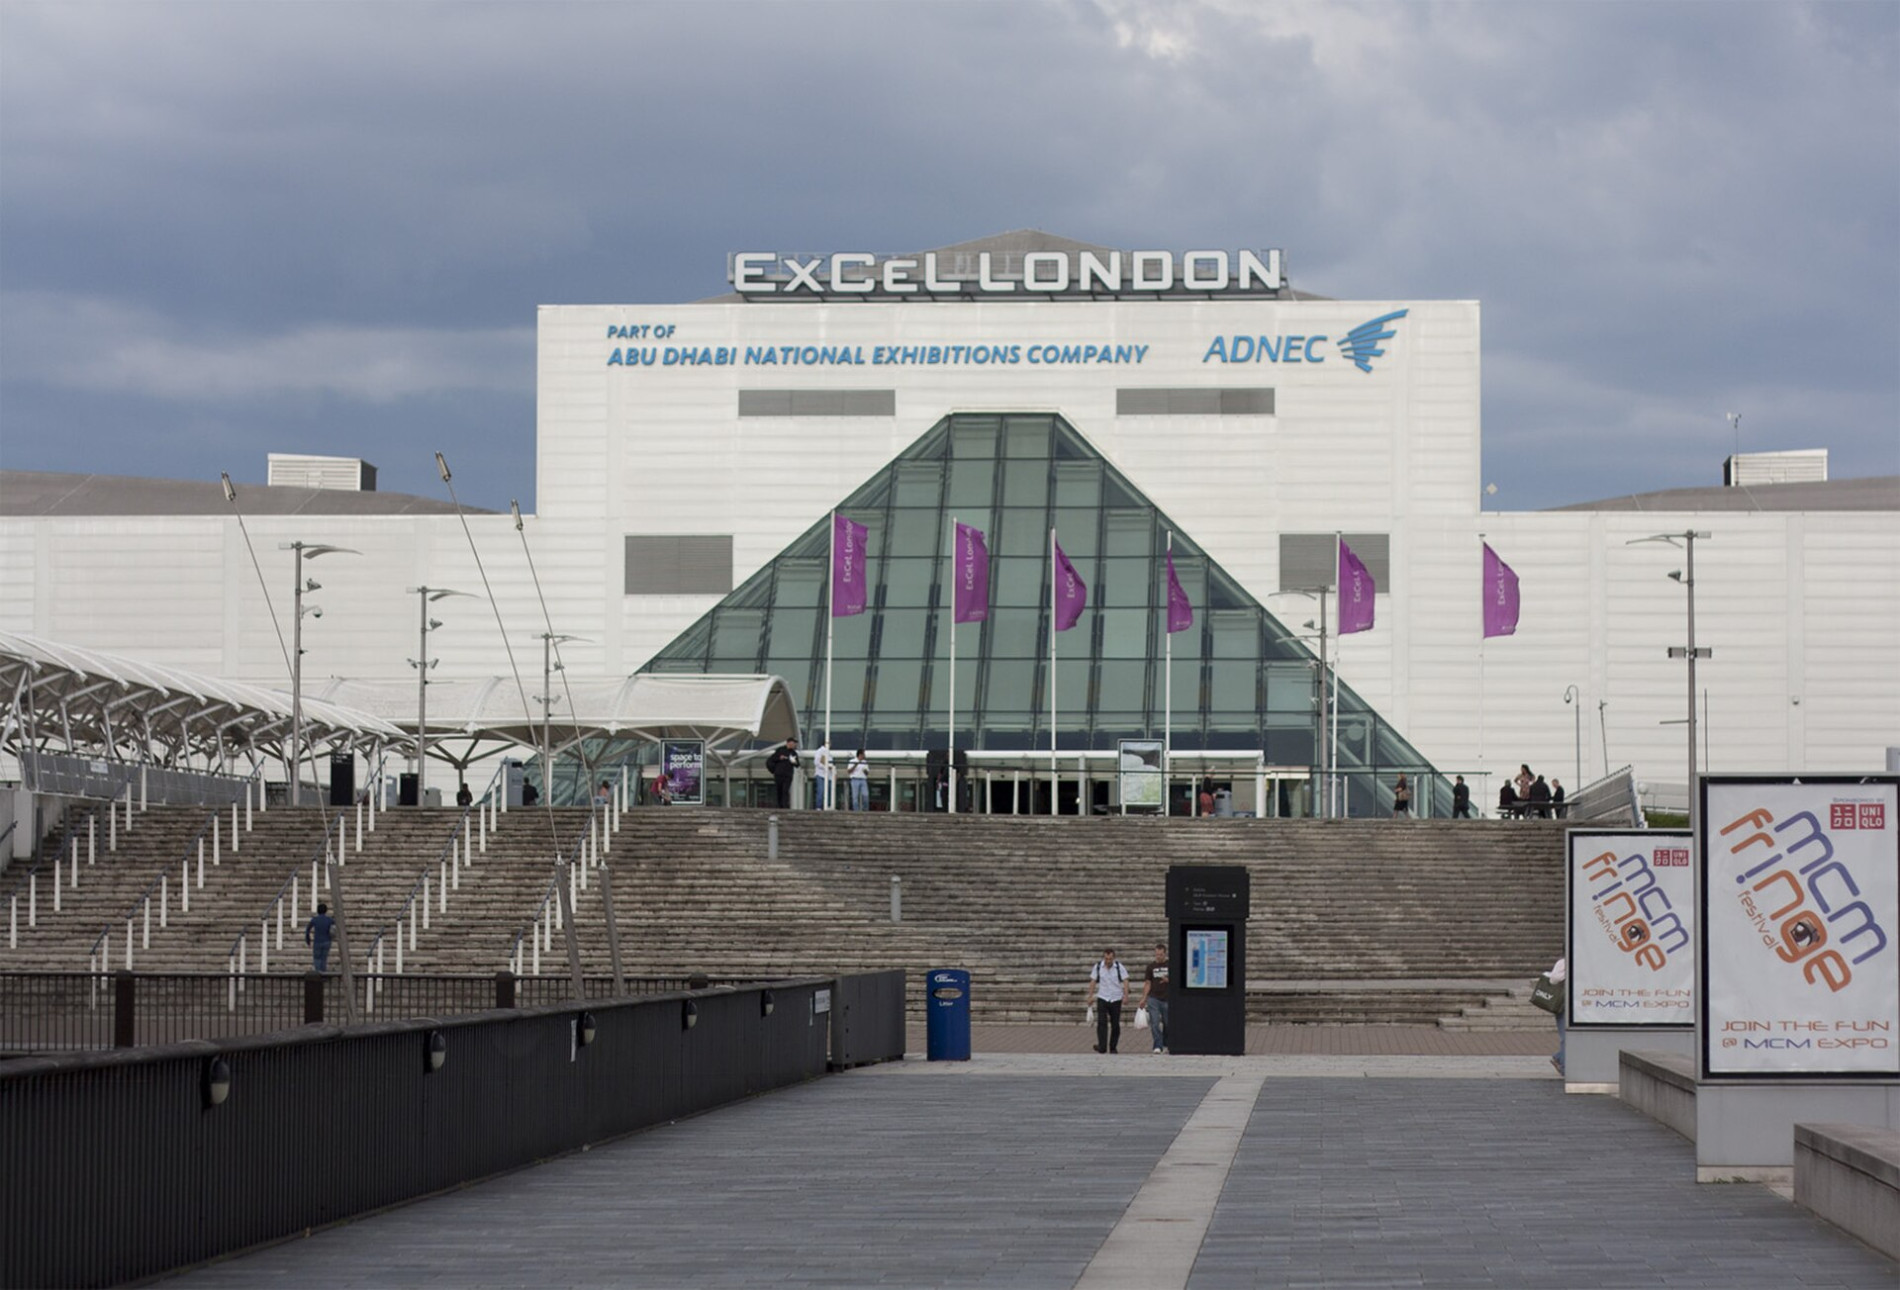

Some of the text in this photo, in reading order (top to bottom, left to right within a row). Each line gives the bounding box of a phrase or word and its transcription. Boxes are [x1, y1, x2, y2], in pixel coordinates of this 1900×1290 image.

[979, 250, 1282, 292] LONDON
[607, 324, 676, 338] PART OF
[607, 344, 1148, 366] ABU DHABI NATIONAL EXHIBITIONS COMPANY
[1202, 335, 1328, 363] ADNEC
[670, 753, 702, 762] space to
[1719, 807, 1853, 993] fringe
[1774, 809, 1888, 966] mcm
[1582, 851, 1667, 972] fringe
[1617, 853, 1690, 955] mcm
[1593, 904, 1622, 943] festival
[1737, 890, 1780, 950] festival
[1581, 988, 1691, 997] JOIN THE FUN
[1596, 1000, 1640, 1008] MCM
[1643, 1000, 1690, 1008] EXPO
[1721, 1020, 1889, 1032] JOIN THE FUN
[1722, 1037, 1888, 1049] @ MCM EXPO
